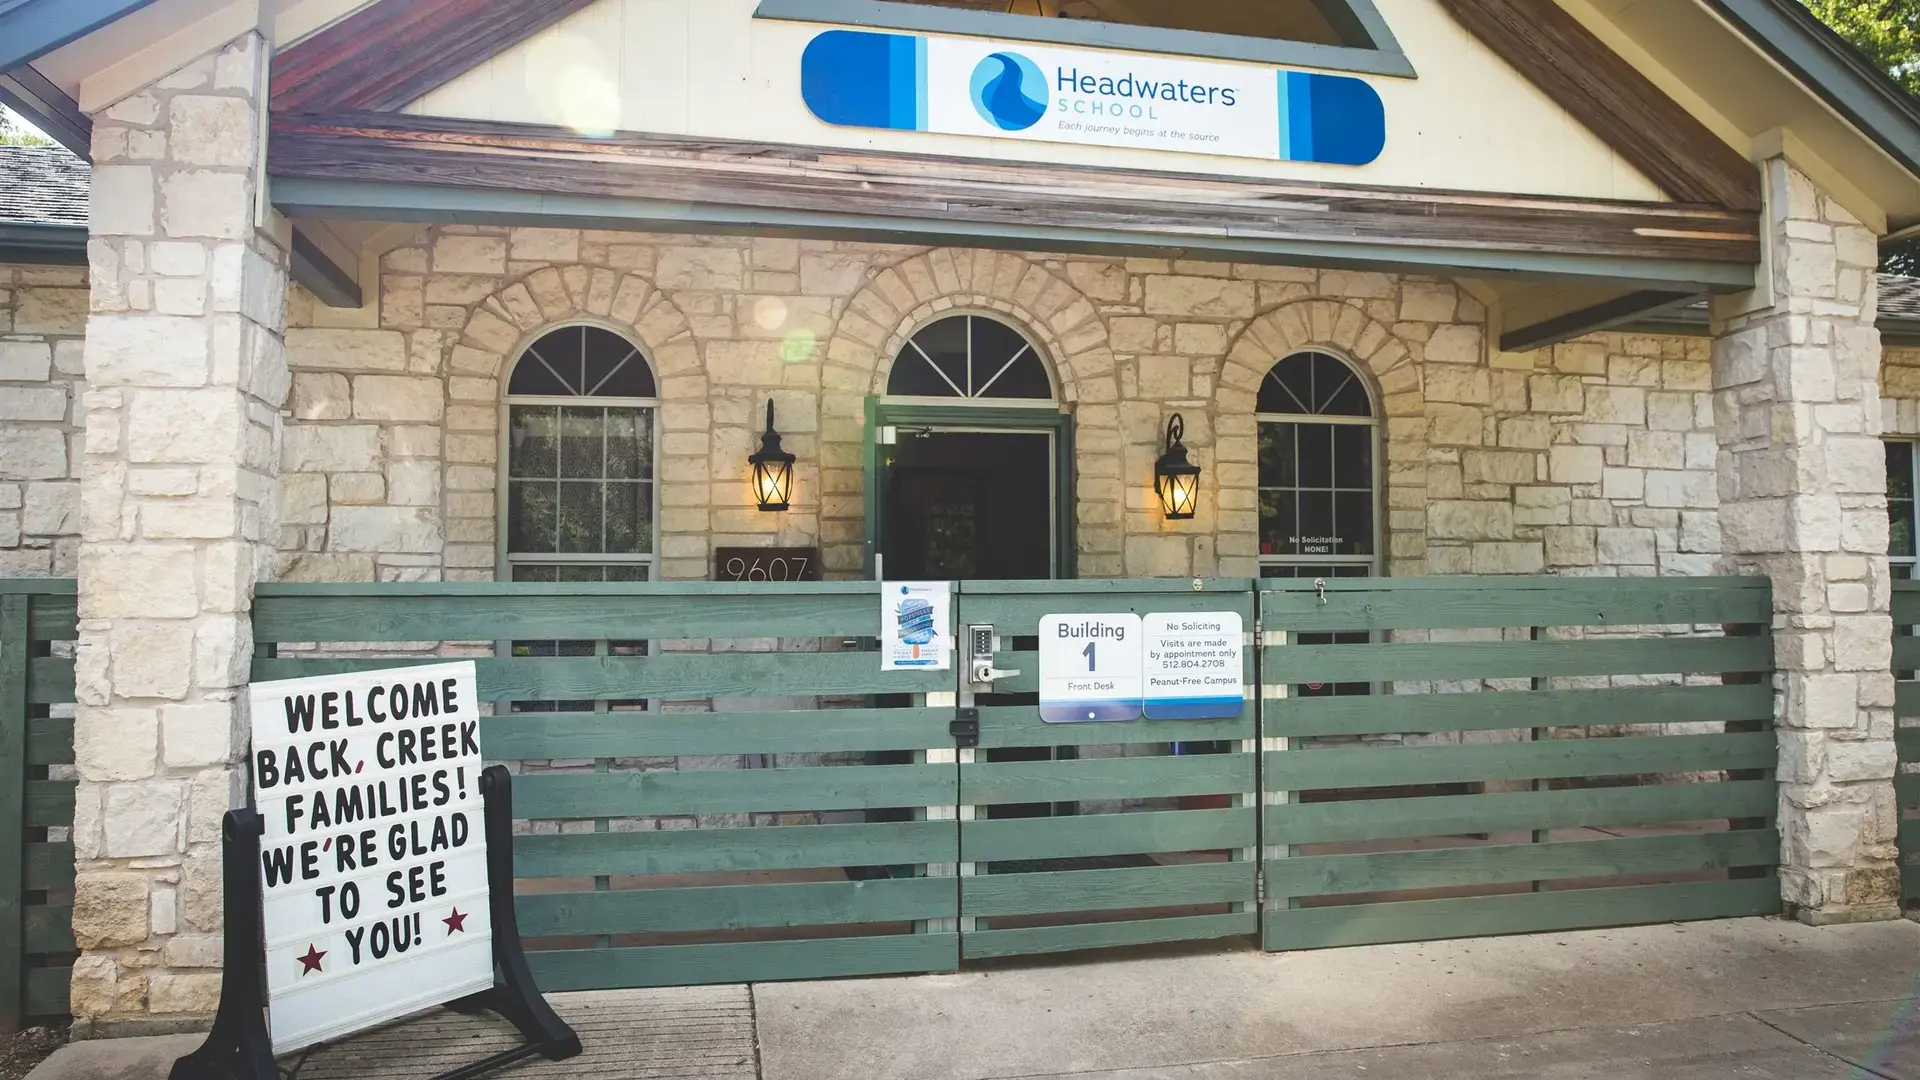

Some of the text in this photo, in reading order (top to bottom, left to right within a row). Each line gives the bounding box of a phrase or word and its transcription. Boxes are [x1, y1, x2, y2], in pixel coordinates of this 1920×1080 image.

[1057, 67, 1236, 107] Headwaters
[1057, 98, 1159, 120] SCHOOL
[1057, 120, 1221, 143] Each journey begins at the source
[1289, 536, 1343, 544] No Solicitation
[726, 557, 809, 581] 9607
[1058, 621, 1125, 641] Building
[1166, 622, 1221, 632] No Soliciting
[1150, 649, 1237, 660] by appointment only
[1160, 639, 1228, 648] Visits are made
[1082, 641, 1096, 672] 1
[1162, 659, 1226, 669] 512.804.2708
[1068, 681, 1115, 691] Front Desk
[1150, 676, 1237, 687] Peanut-Free Campus
[284, 678, 459, 734] WELCOME
[256, 720, 479, 789] BACK, CREEK
[286, 766, 467, 835] FAMILIES!
[262, 812, 469, 888] WE'RE GLAD
[315, 861, 447, 924] TO SEE
[345, 911, 423, 965] YOU!
